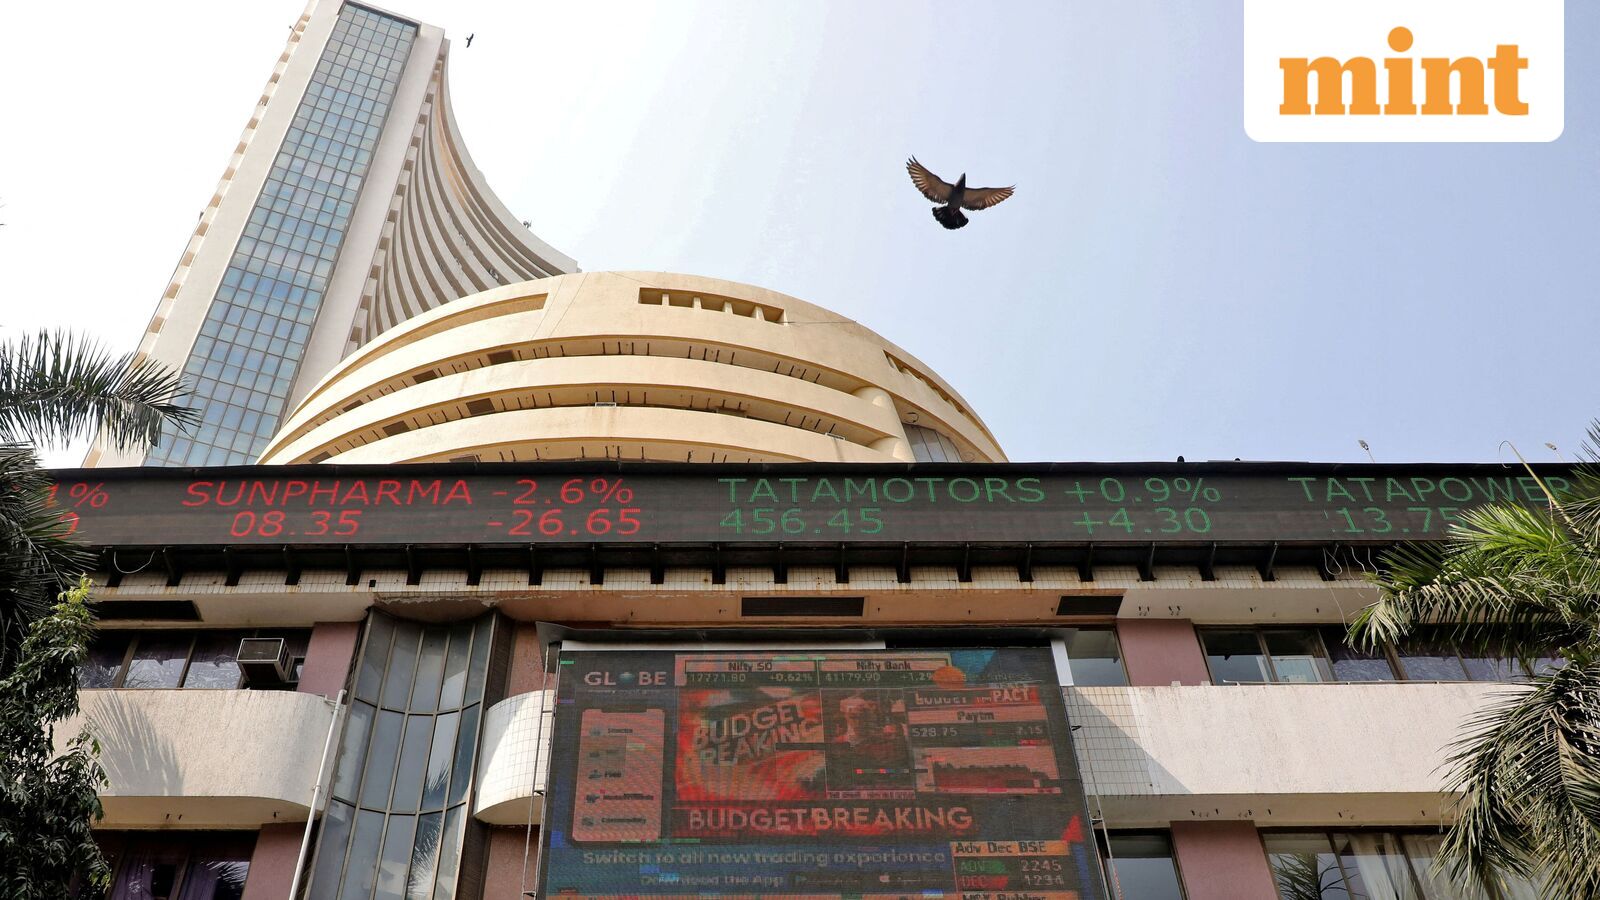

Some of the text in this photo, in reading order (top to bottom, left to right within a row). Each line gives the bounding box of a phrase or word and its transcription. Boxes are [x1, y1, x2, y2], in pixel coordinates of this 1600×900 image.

[181, 477, 635, 508] SUNPHARMA -2.6%
[717, 476, 1221, 503] TATAMOTORS +0.9%
[1287, 476, 1571, 502] TATAPOWER
[229, 507, 642, 538] 08.35 -26.65
[718, 507, 1212, 535] 456.45 +4.30
